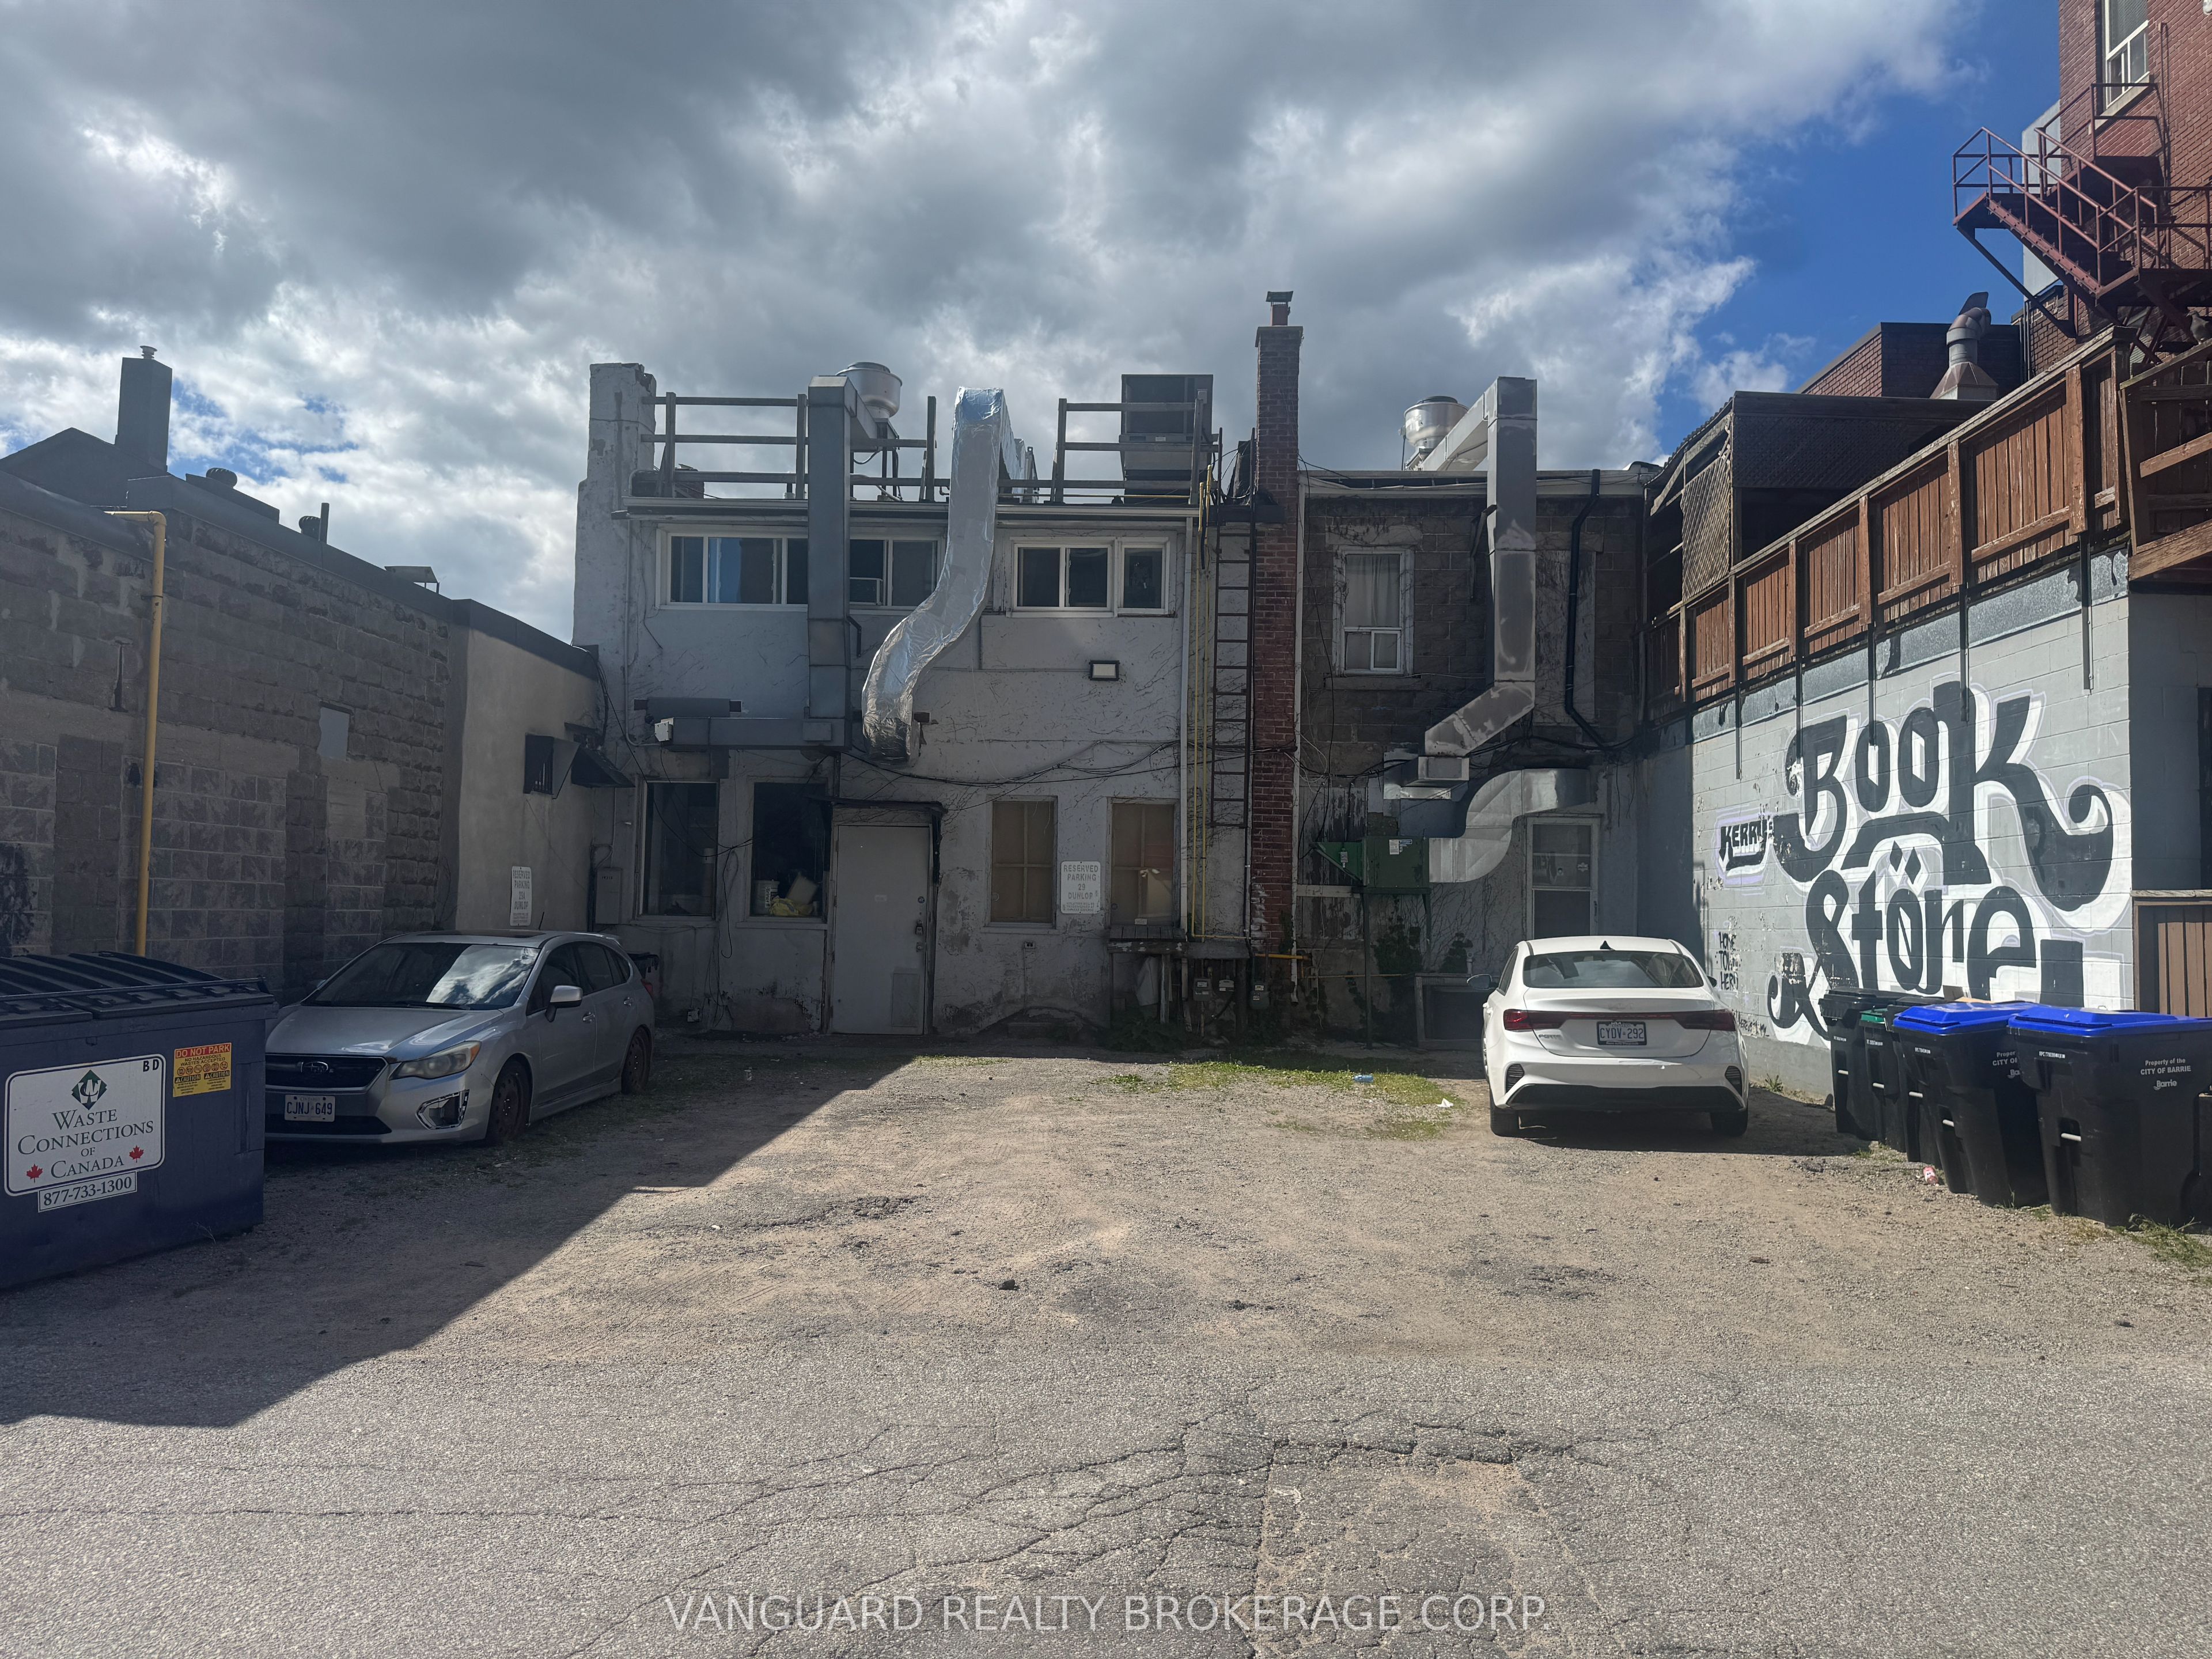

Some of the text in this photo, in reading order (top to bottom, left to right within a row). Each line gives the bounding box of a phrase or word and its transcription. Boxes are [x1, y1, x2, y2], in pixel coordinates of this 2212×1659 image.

[1773, 681, 2113, 911] Book
[1600, 1028, 1643, 1039] CYDV 292
[176, 1044, 230, 1058] DO NOT PARK
[143, 1059, 160, 1072] B D
[2167, 1065, 2191, 1073] BARRIE
[2156, 1079, 2177, 1088] Barrie
[287, 1101, 332, 1115] CJNJ 649
[51, 1109, 118, 1130] WASTE
[18, 1120, 153, 1154] CONNECTIONS
[81, 1147, 95, 1157] OF
[51, 1155, 124, 1178] CANADA
[44, 1176, 132, 1206] 877-733-1300
